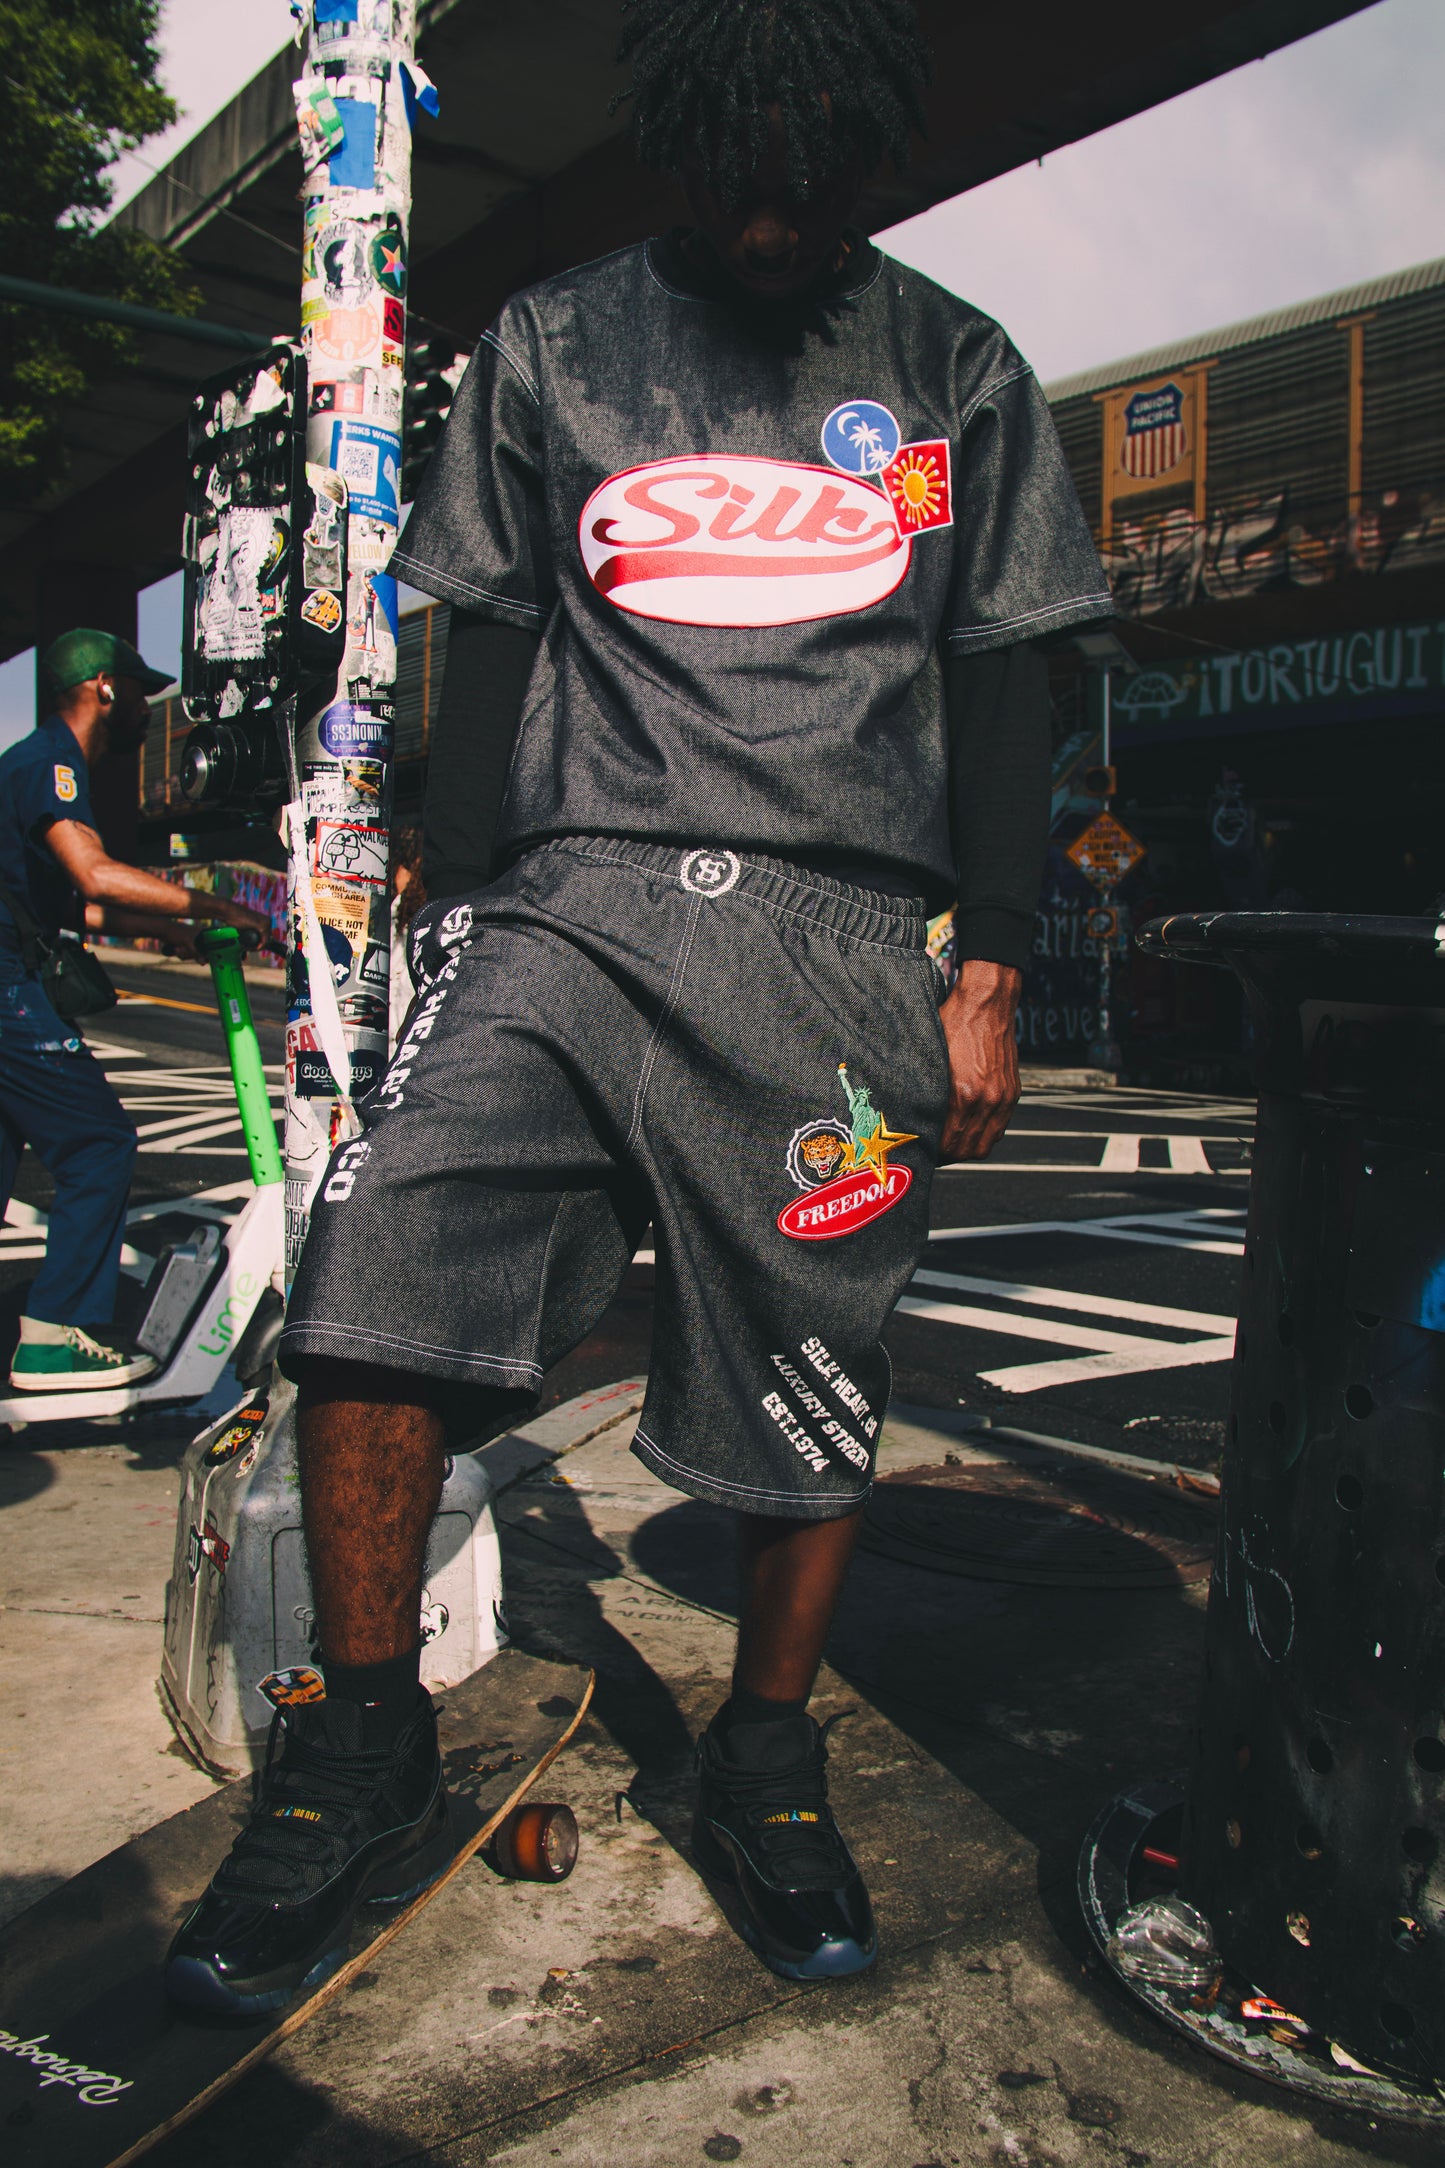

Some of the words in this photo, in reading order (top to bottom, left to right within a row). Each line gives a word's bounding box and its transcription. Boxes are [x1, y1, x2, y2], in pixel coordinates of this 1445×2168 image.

[1133, 393, 1175, 414] UNION
[1131, 406, 1177, 427] PACIFIC
[591, 471, 897, 548] Silk
[331, 724, 382, 742] KINDNESS
[54, 764, 77, 802] 5
[344, 894, 366, 903] AREA
[317, 916, 343, 929] OLICE
[345, 920, 364, 930] NOT
[796, 1175, 896, 1229] FREEDOM
[198, 1272, 258, 1356] Lime
